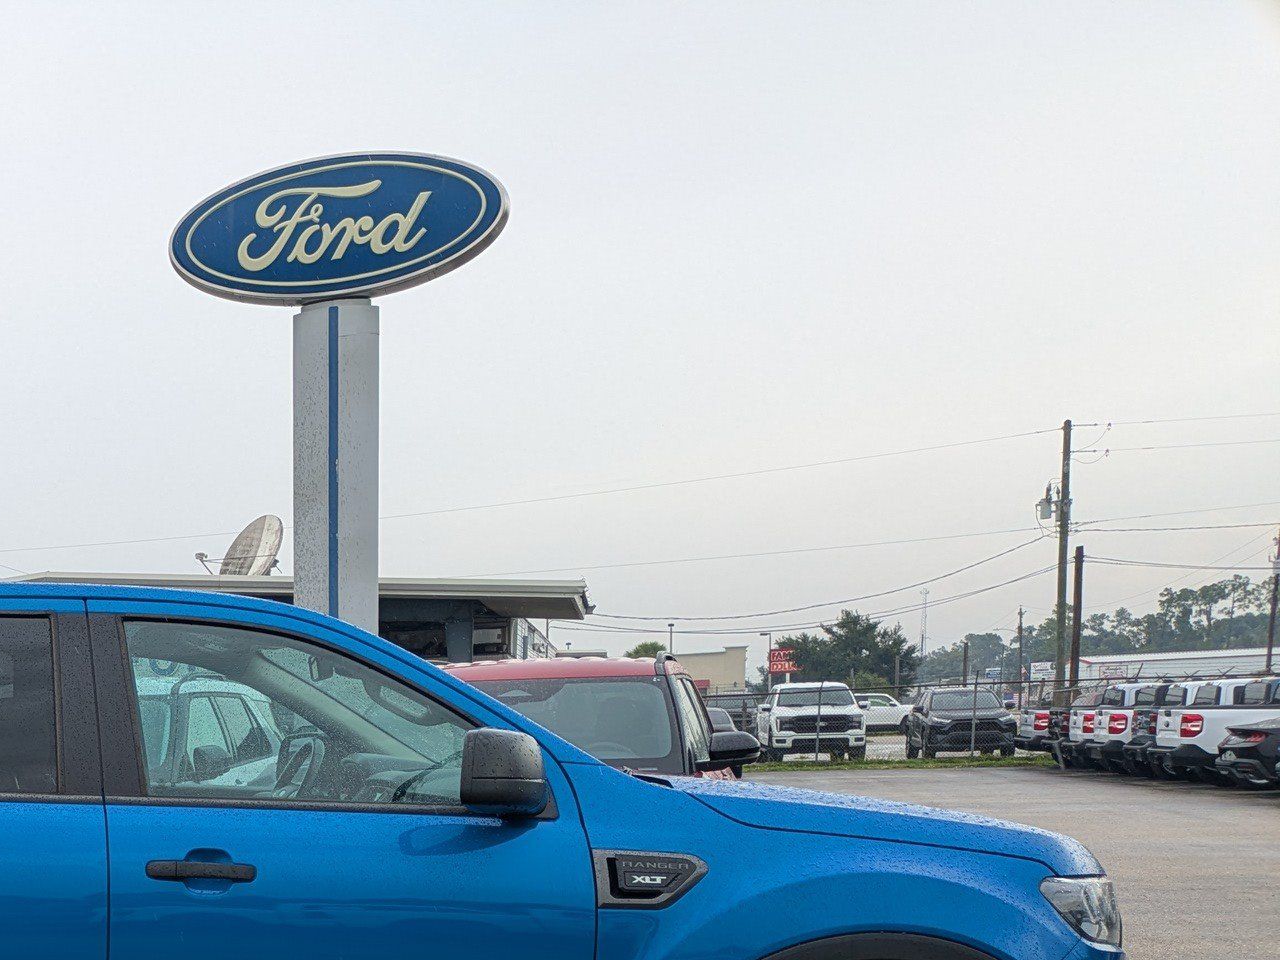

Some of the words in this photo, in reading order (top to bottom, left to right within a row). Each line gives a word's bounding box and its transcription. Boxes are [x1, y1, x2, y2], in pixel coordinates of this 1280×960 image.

[238, 179, 432, 271] Ford
[622, 861, 690, 870] RANGER
[632, 875, 667, 884] XLT
